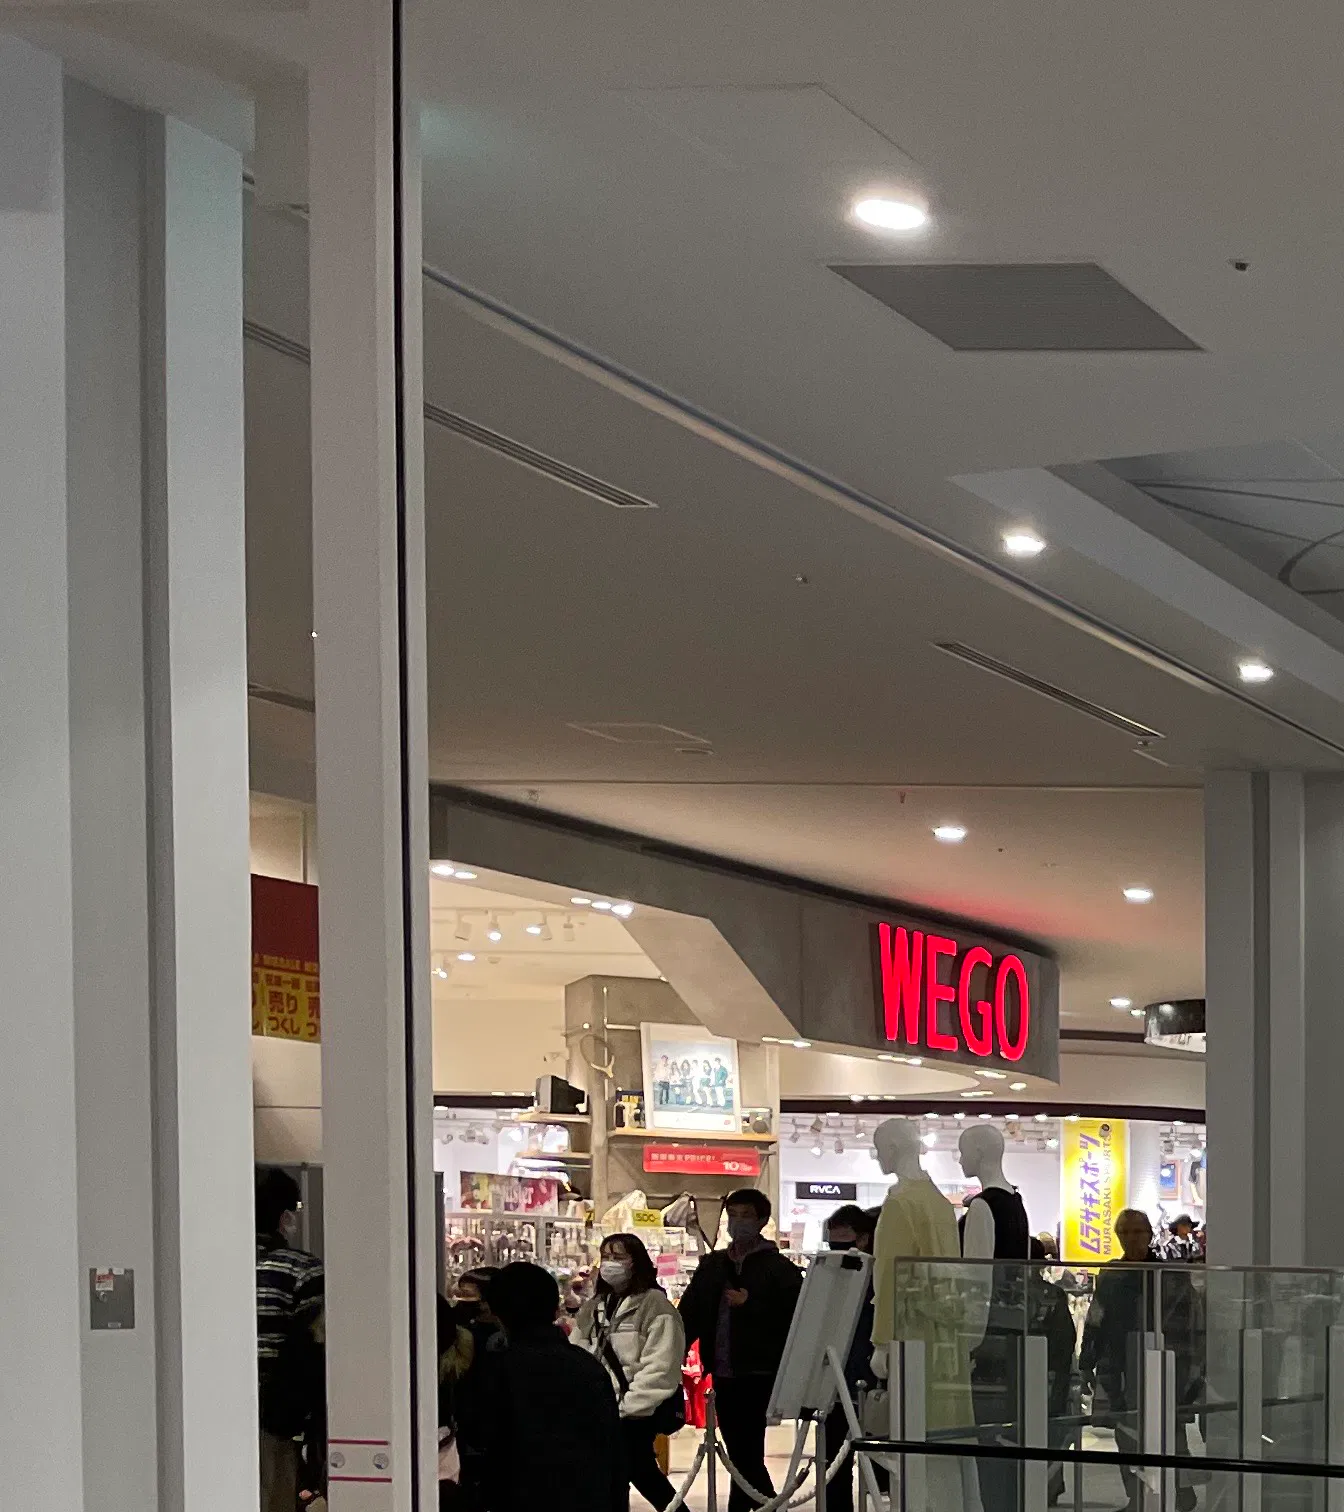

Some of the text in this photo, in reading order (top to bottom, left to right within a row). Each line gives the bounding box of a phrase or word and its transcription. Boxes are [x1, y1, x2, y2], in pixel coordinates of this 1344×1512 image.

[878, 922, 1029, 1061] WEGO
[809, 1184, 841, 1194] RVCA
[1080, 1132, 1101, 1255] ムラサキスポーツ
[1103, 1187, 1112, 1255] MURASAKI
